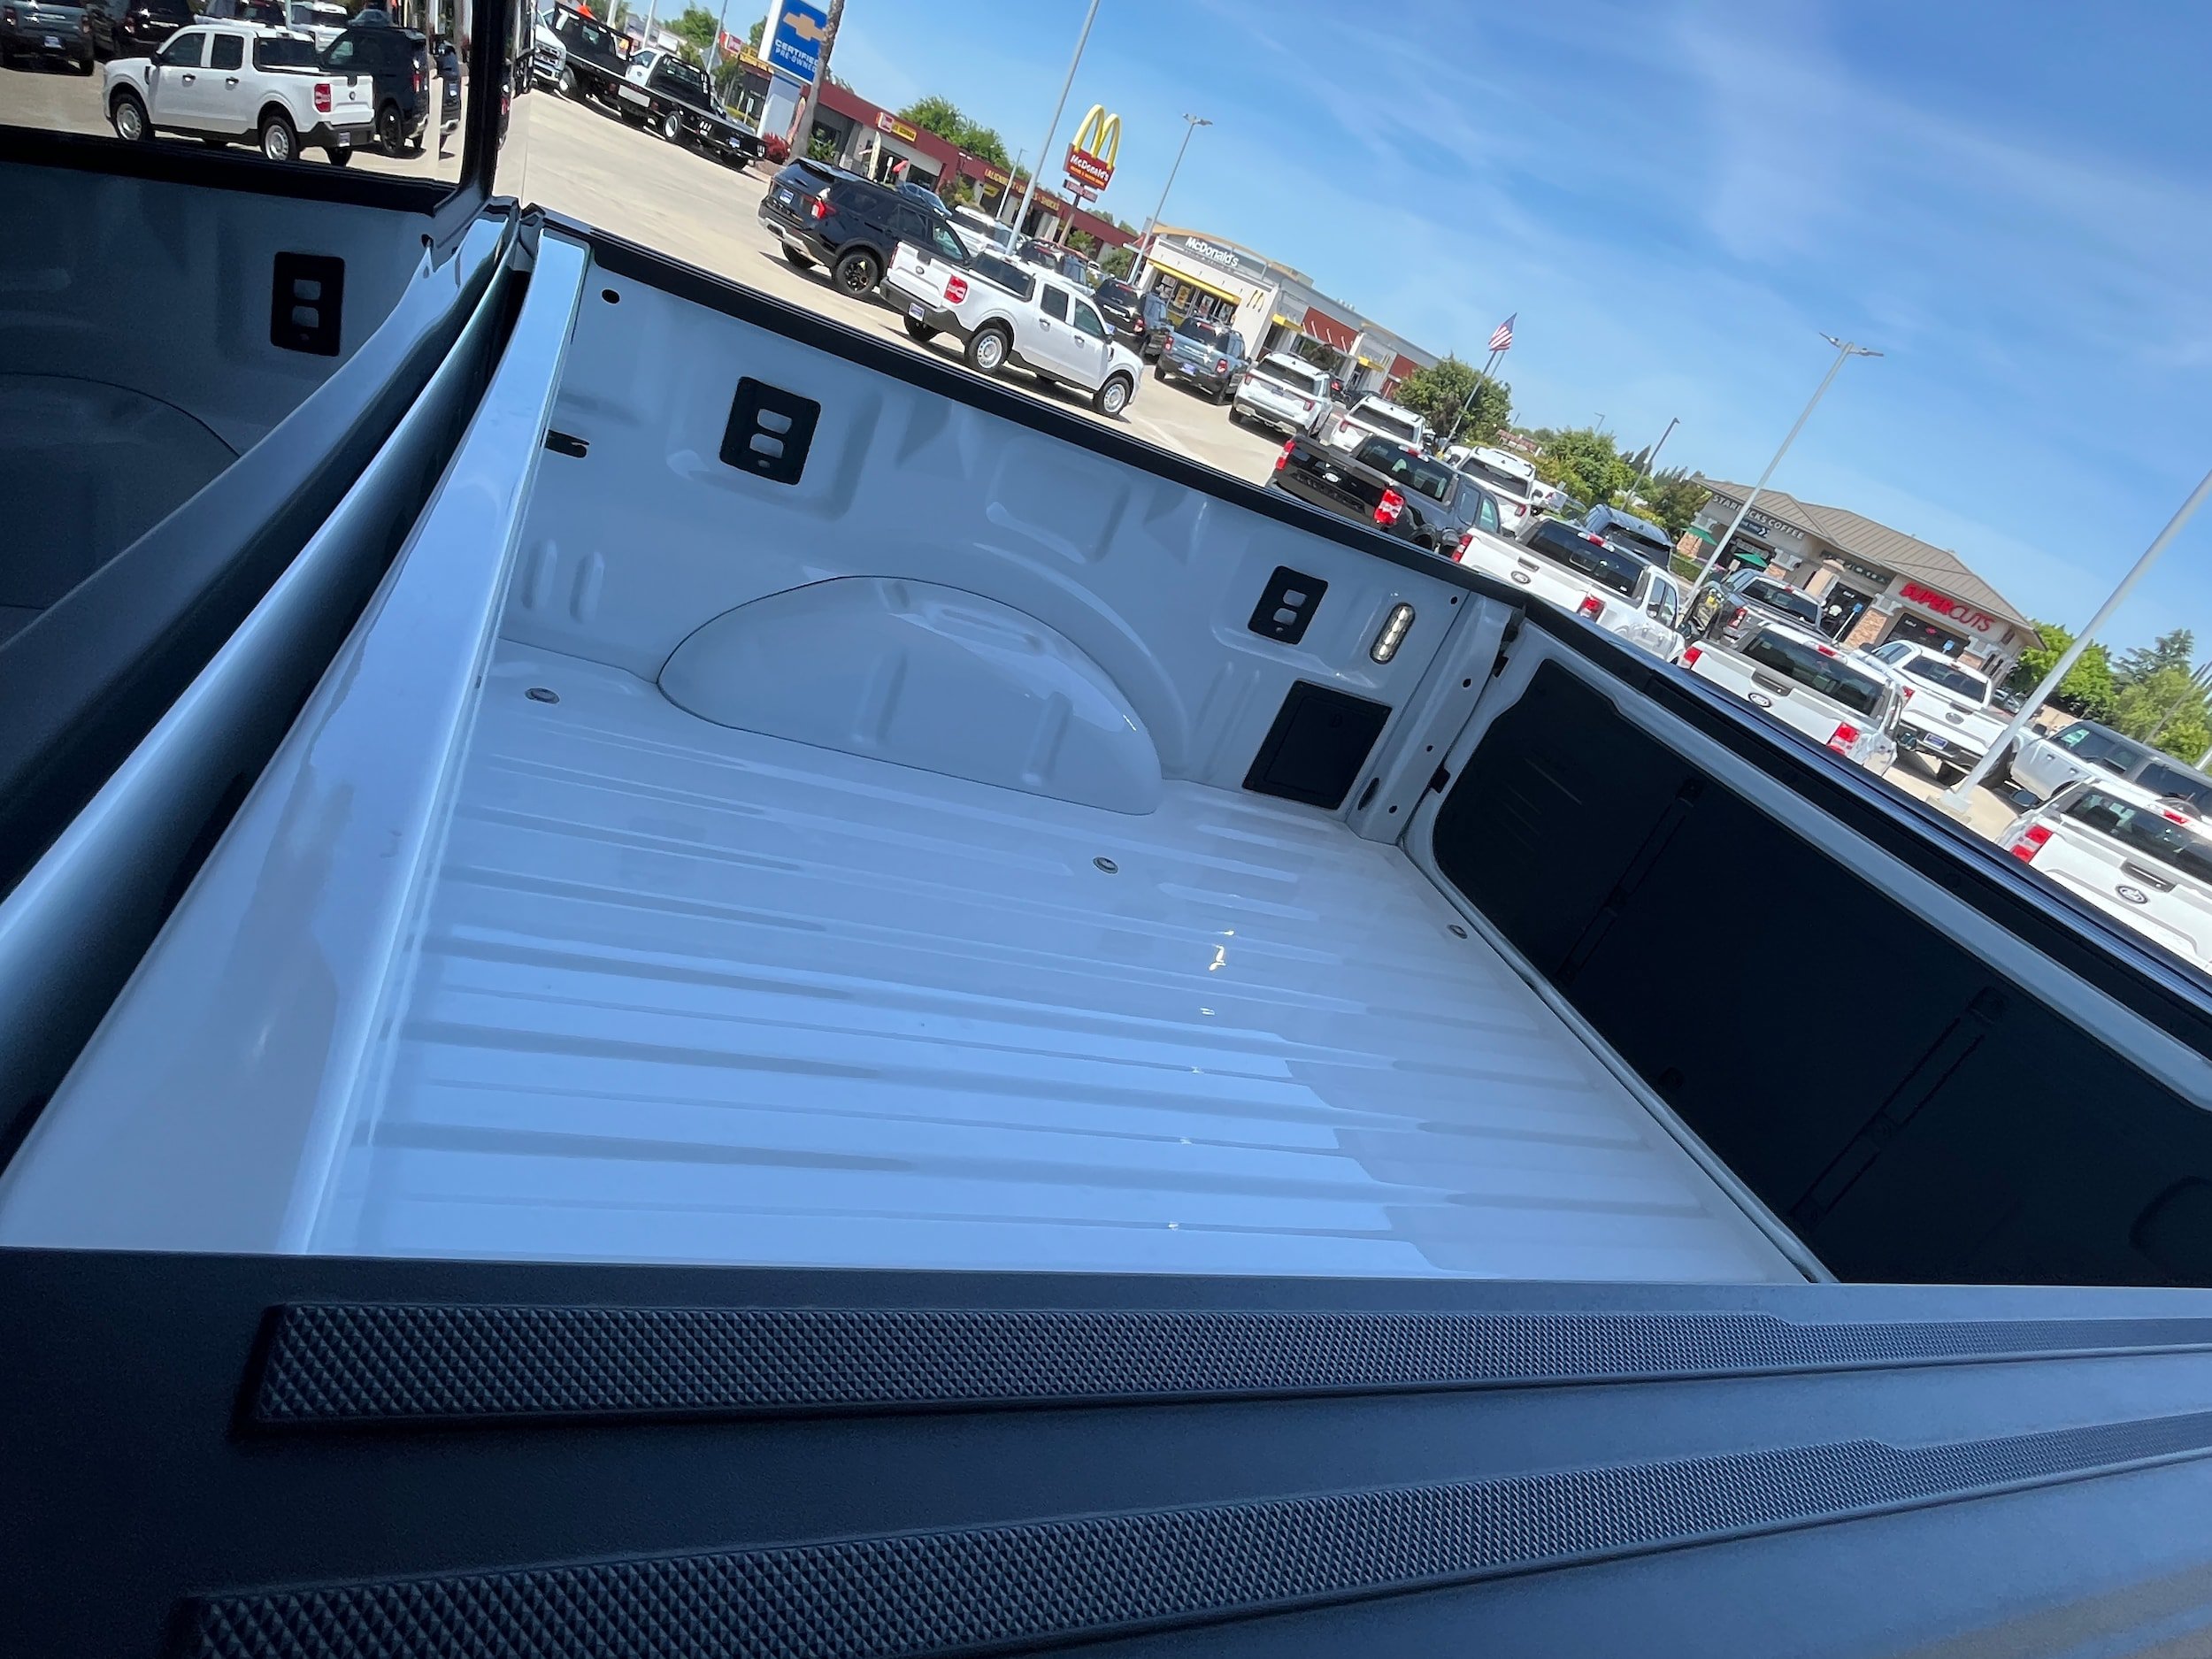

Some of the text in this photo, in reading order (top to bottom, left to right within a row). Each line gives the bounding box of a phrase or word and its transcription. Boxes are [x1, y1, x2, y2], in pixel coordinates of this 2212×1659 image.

[1070, 154, 1109, 181] McDonald's
[1186, 236, 1239, 267] McDonald's
[1768, 518, 1804, 541] COFFEE
[1899, 583, 1996, 633] SUPERCUTS
